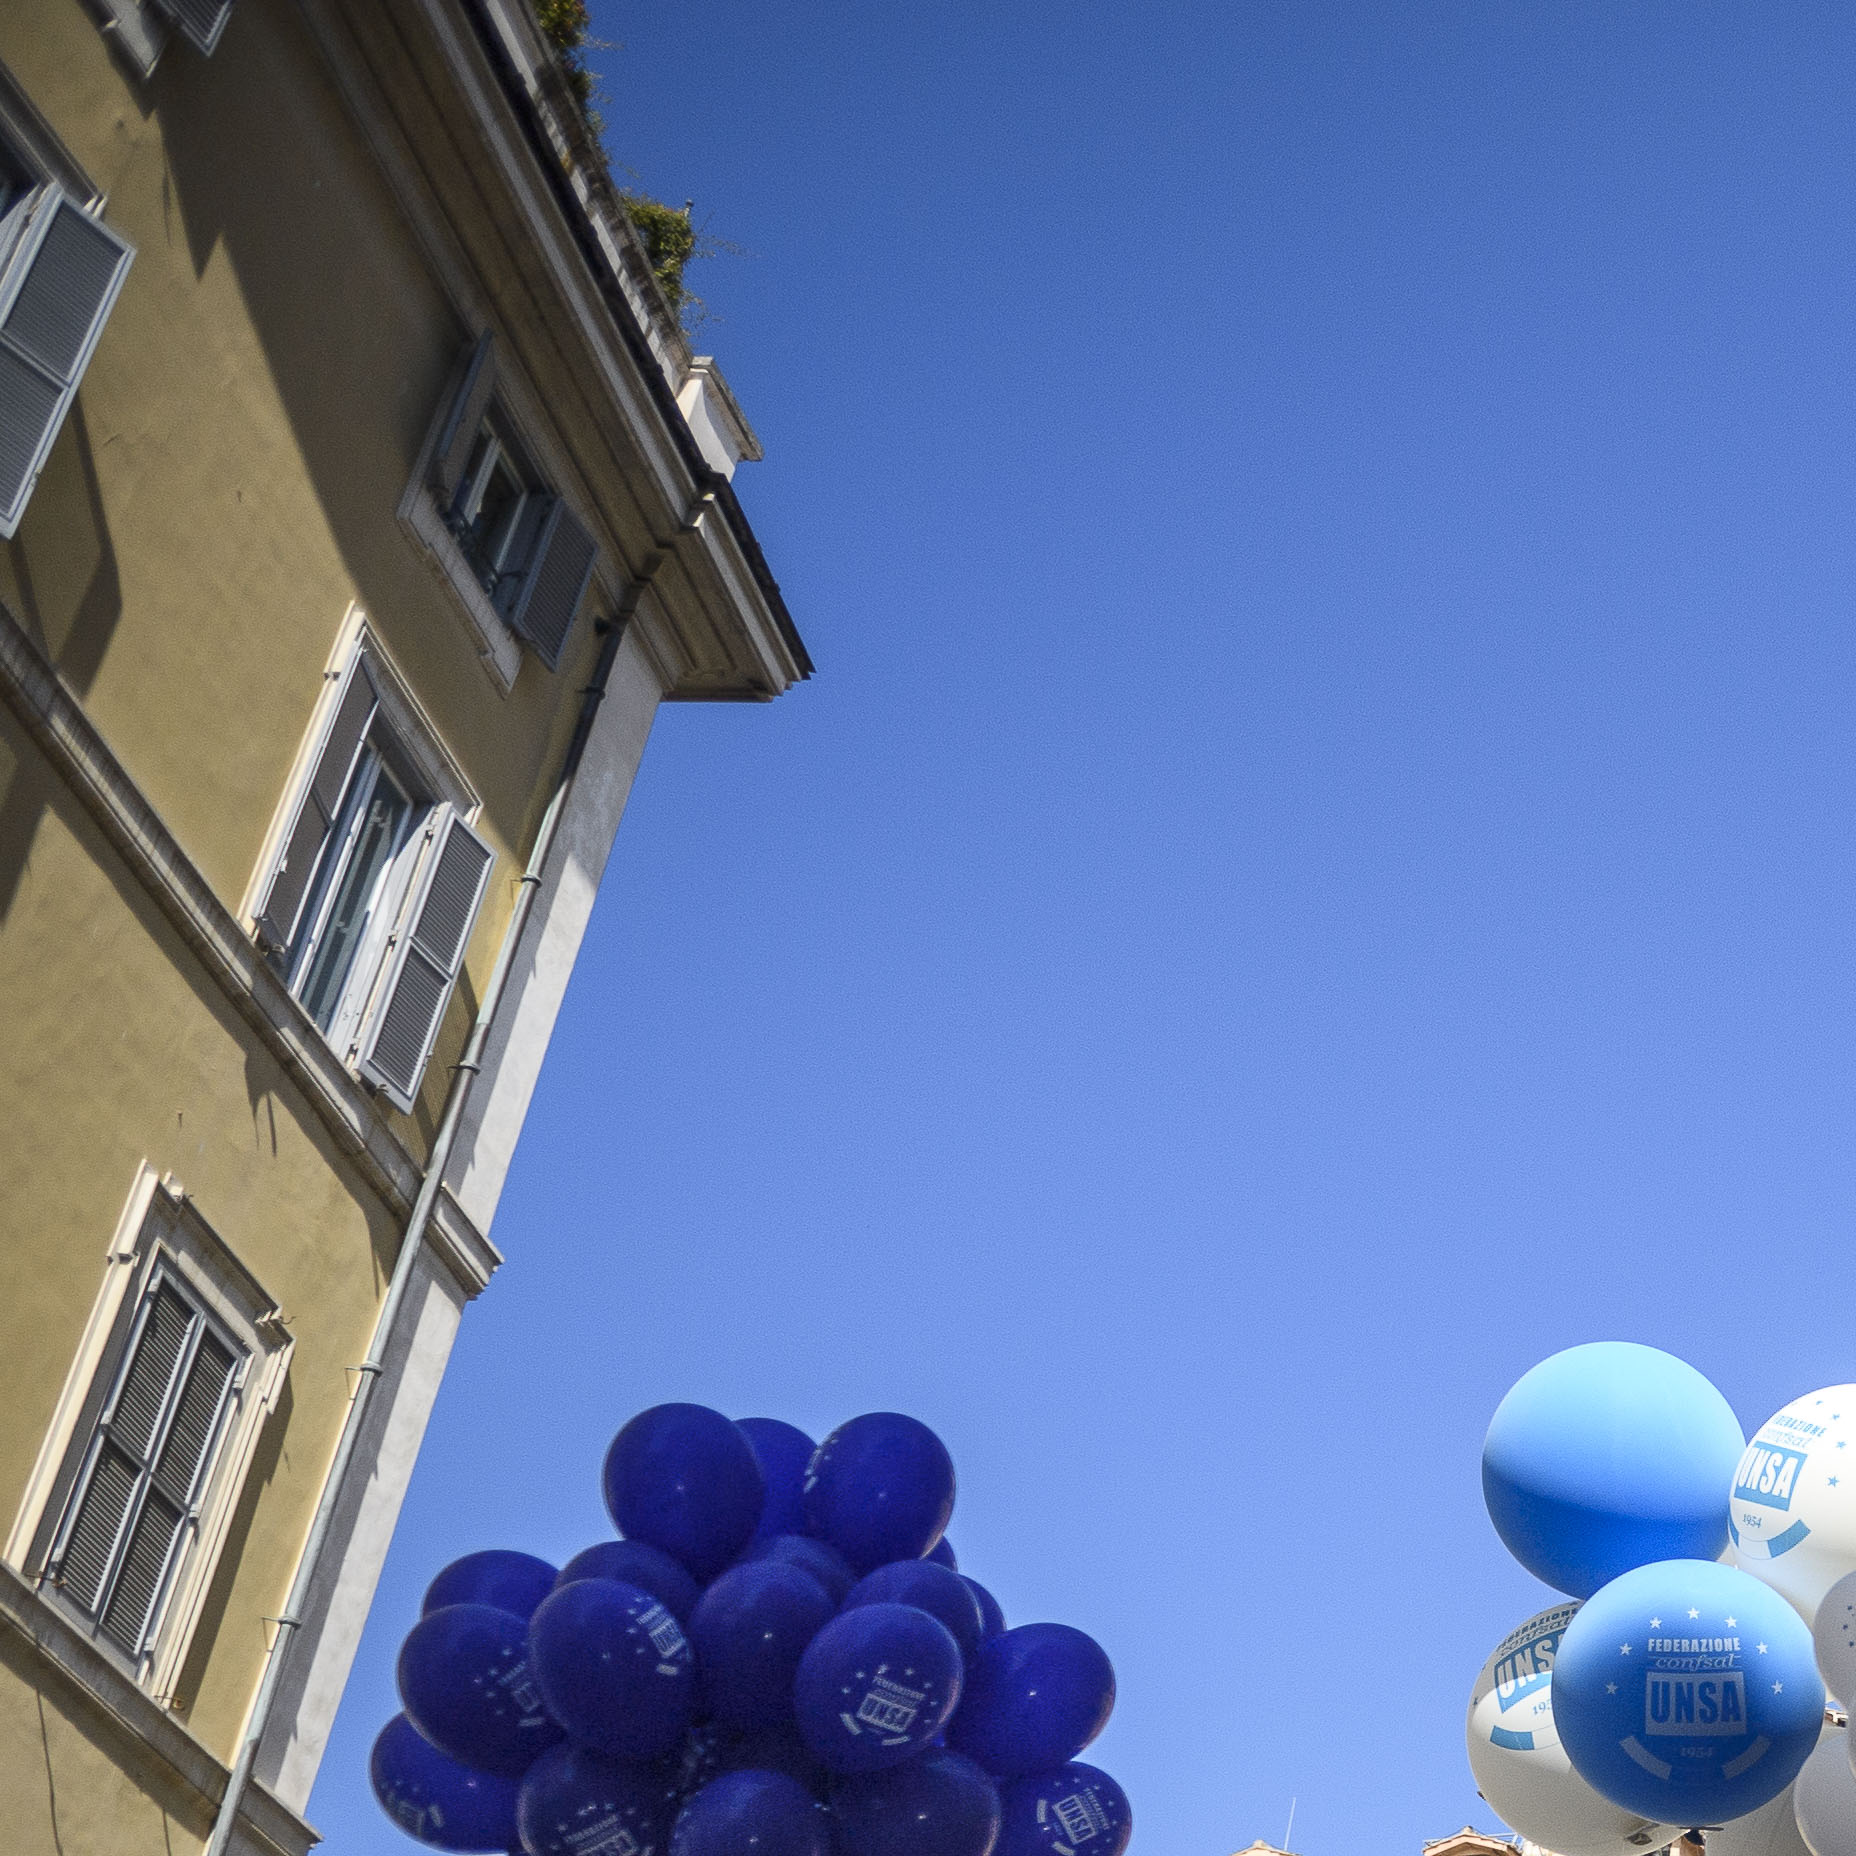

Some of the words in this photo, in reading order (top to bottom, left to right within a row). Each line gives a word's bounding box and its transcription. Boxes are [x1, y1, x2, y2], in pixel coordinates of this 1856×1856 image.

[1737, 1446, 1800, 1499] UNSA
[1742, 1513, 1762, 1529] 1954
[1648, 1637, 1741, 1653] FEDERAZIONE
[1655, 1653, 1737, 1672] confsal
[1650, 1680, 1740, 1726] UNSA
